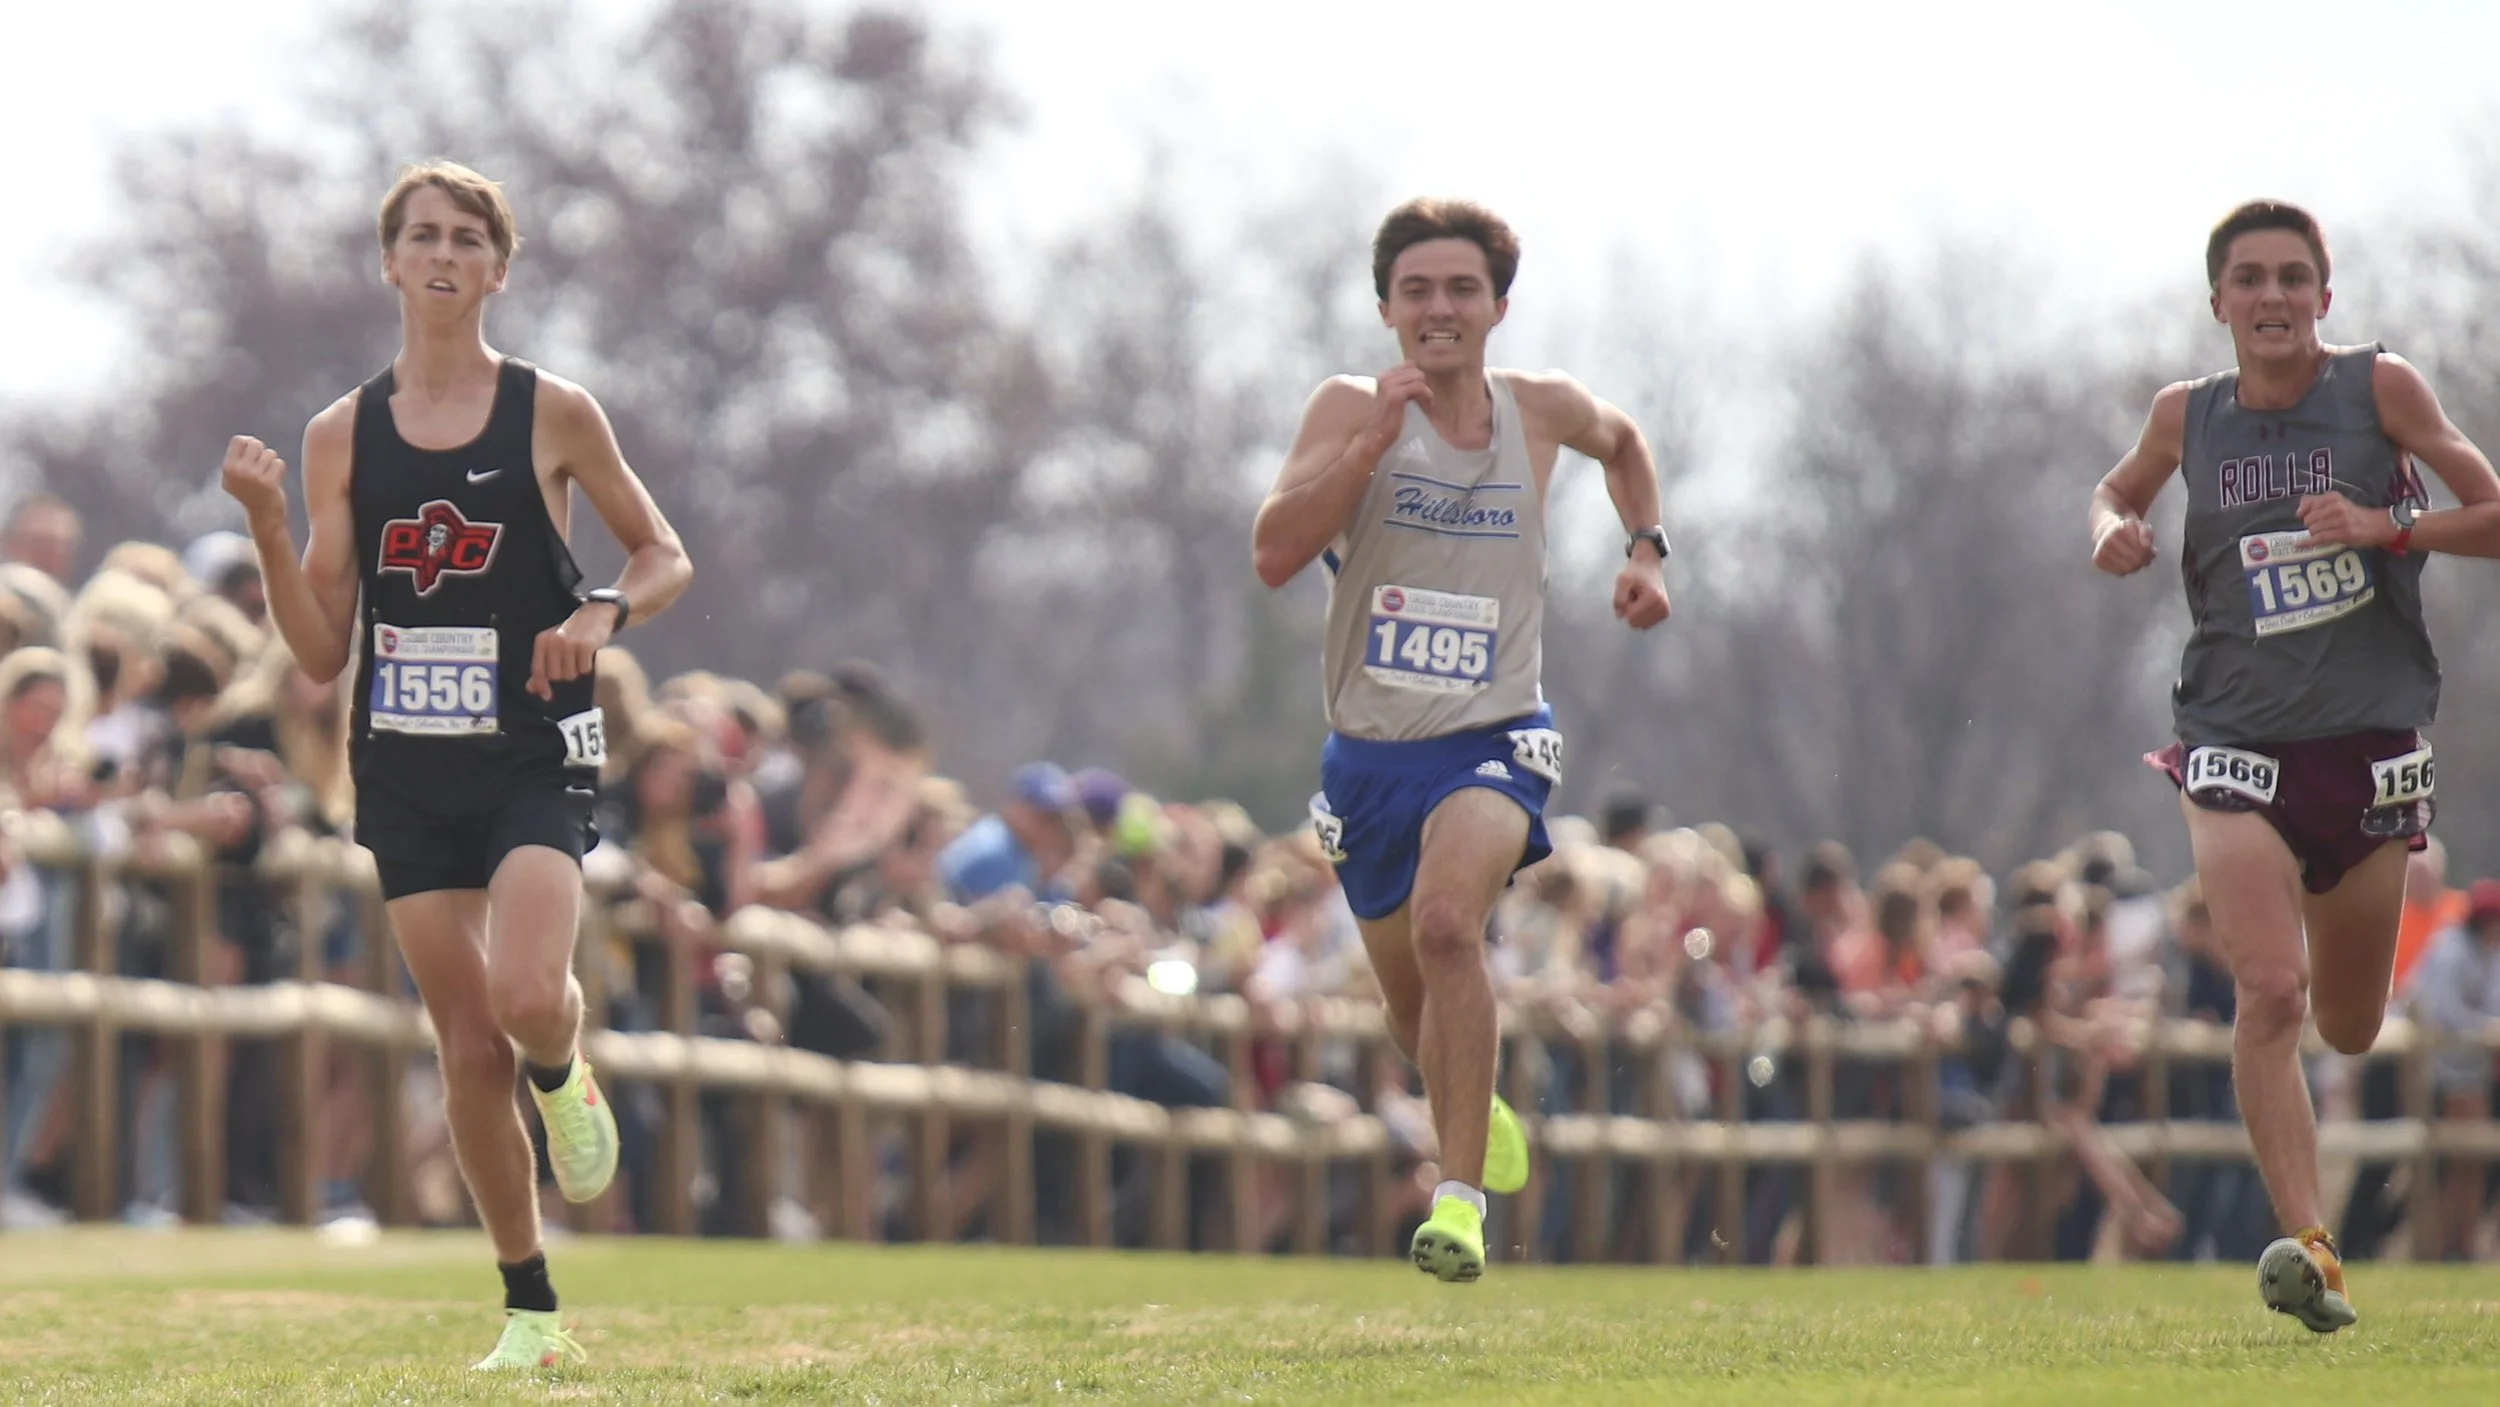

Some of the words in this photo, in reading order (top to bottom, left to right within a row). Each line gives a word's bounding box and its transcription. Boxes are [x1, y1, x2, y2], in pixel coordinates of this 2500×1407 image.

[2220, 447, 2332, 508] ROLLA
[1394, 486, 1516, 526] Hillsboro
[2252, 550, 2366, 611] 1569
[1375, 619, 1490, 676] 1495
[379, 662, 492, 712] 1556
[570, 722, 605, 758] 15
[2191, 751, 2274, 791] 1569
[2381, 759, 2434, 797] 156
